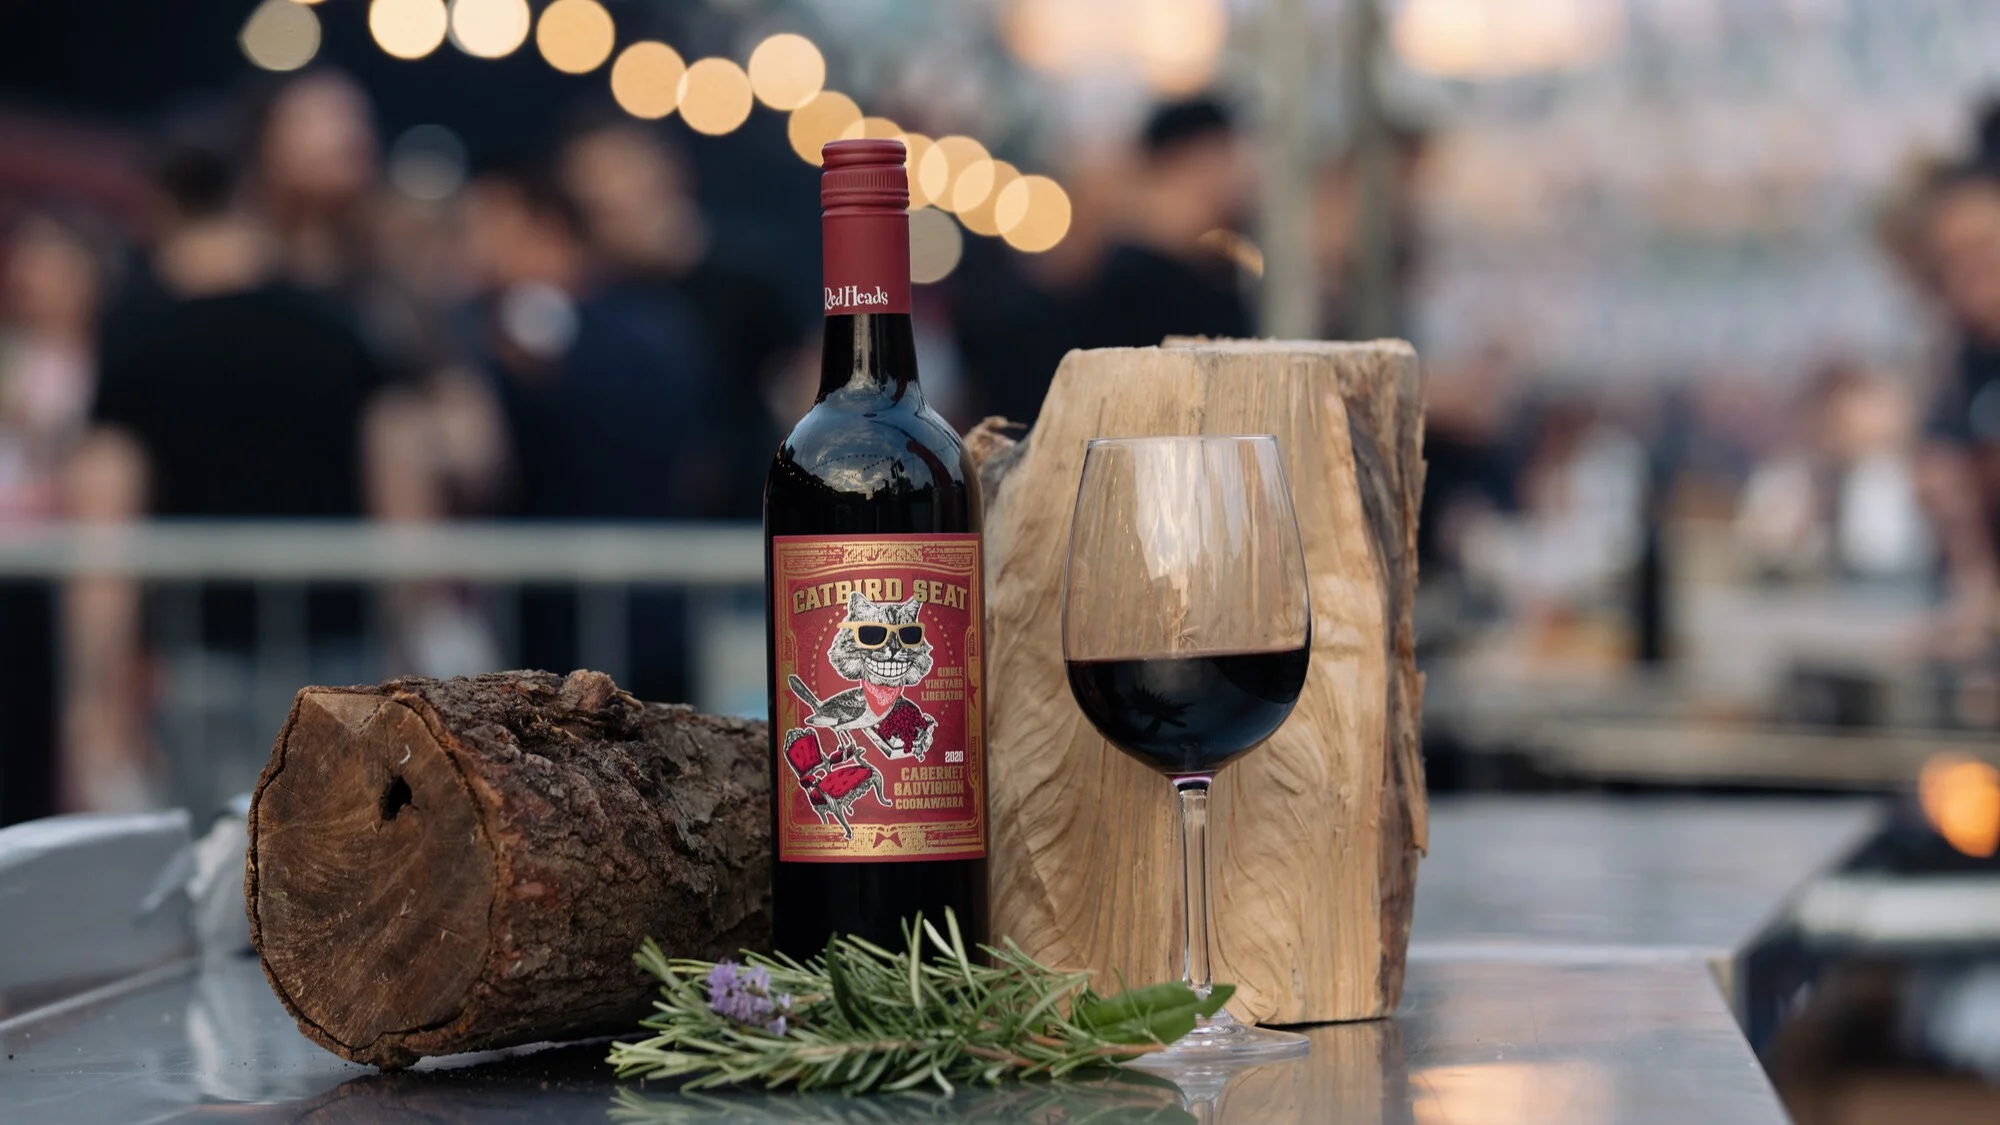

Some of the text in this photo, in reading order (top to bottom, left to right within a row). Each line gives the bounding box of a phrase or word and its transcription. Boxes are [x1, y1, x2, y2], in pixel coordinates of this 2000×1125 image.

[792, 577, 968, 615] CATBIRD SEAT
[924, 678, 964, 689] VINEYARD
[921, 690, 964, 701] LIBERATOR
[945, 750, 964, 763] 2020
[901, 765, 964, 781] CABERNET
[893, 779, 964, 797] SAUVIGNON
[895, 796, 964, 811] COONAWARRA
